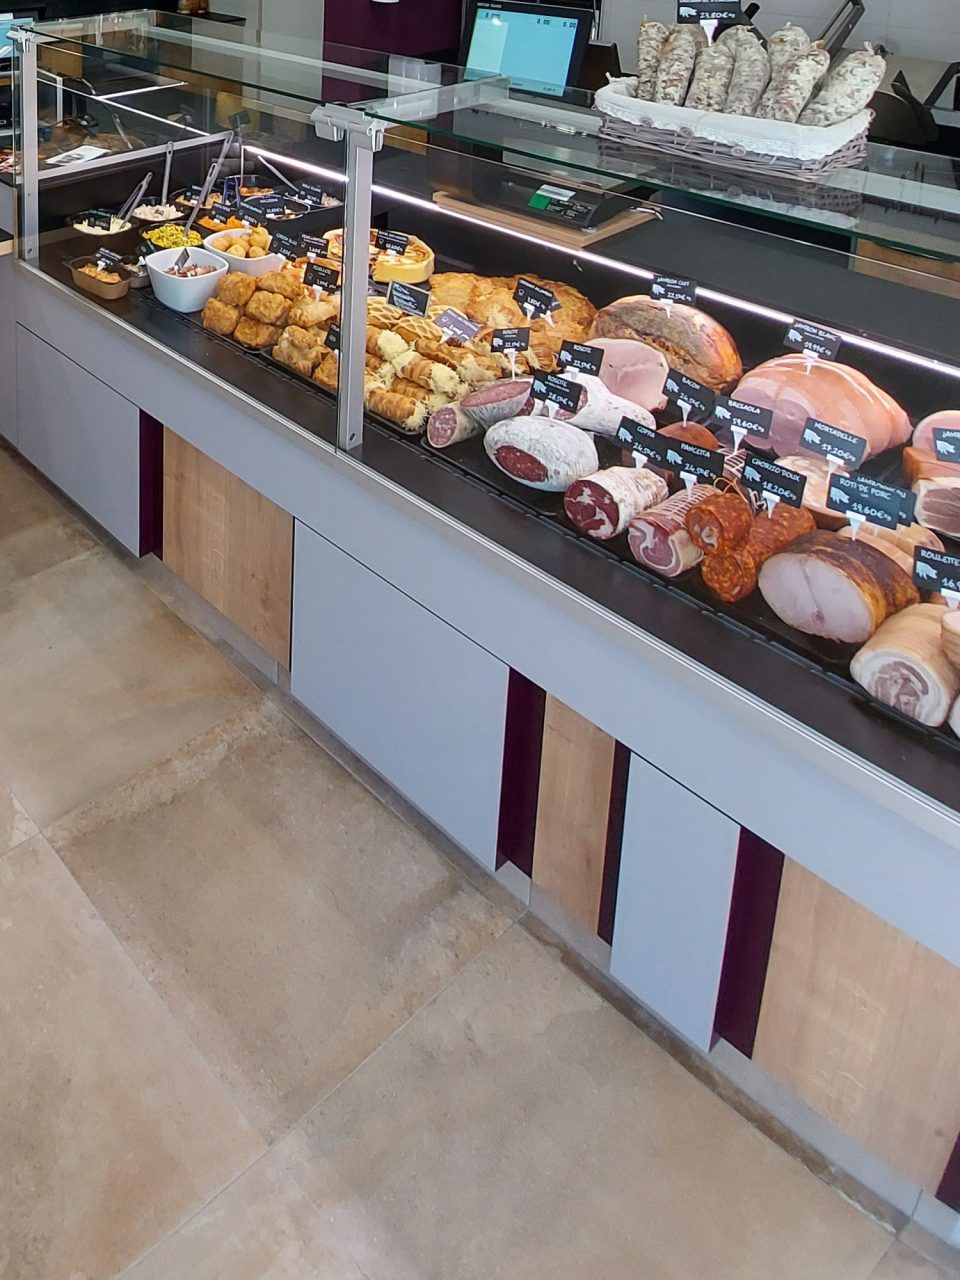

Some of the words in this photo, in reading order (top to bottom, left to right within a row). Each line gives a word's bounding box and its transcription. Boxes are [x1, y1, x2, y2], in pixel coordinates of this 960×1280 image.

[728, 400, 761, 414] BRESAOLA
[636, 426, 655, 438] COPPA
[814, 422, 858, 444] MORTADELLE
[752, 458, 780, 474] CHORIZO
[780, 469, 801, 482] DOUX
[858, 483, 868, 492] DE
[871, 488, 892, 500] PORC
